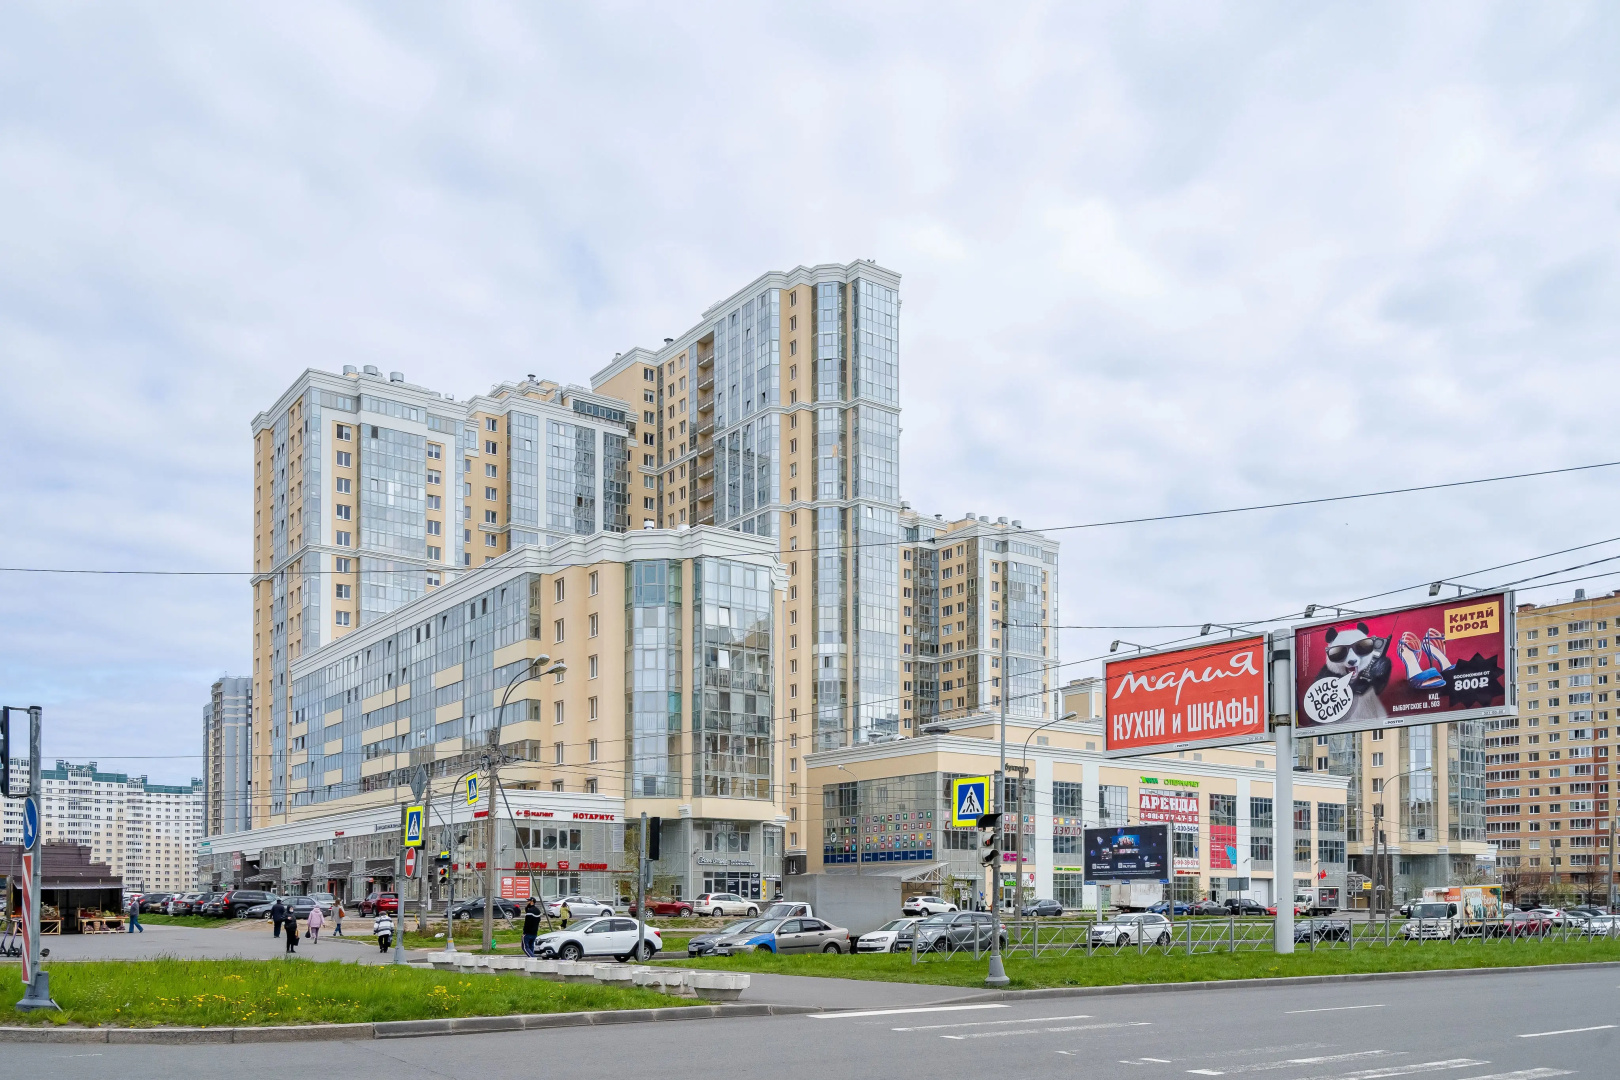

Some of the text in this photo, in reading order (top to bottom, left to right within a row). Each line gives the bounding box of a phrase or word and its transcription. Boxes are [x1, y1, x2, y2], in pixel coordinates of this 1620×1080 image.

[1449, 619, 1489, 634] ГОРОД
[1113, 695, 1259, 741] КУХНИ и ШКАФЫ
[1141, 795, 1198, 813] АРЕНДА
[573, 812, 615, 820] НОТАРИУС
[578, 862, 607, 870] ПОШИВ
